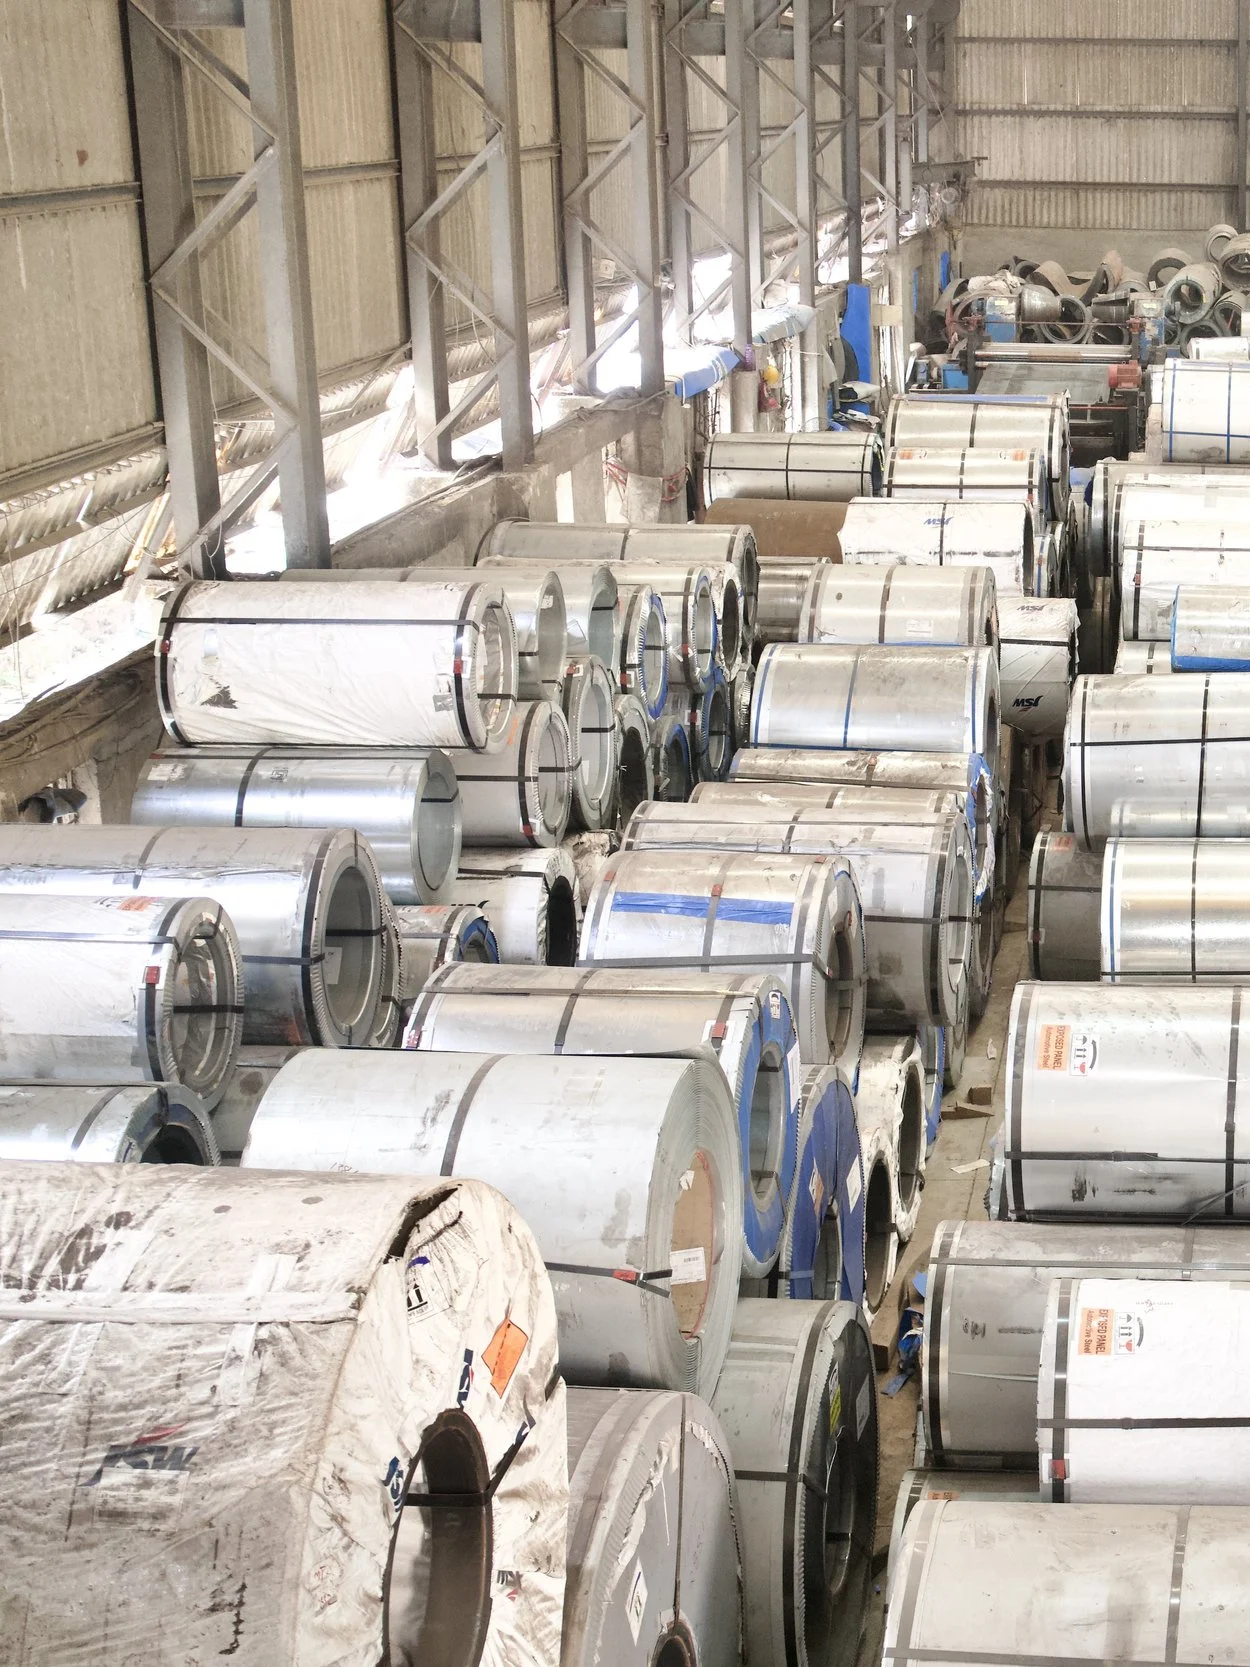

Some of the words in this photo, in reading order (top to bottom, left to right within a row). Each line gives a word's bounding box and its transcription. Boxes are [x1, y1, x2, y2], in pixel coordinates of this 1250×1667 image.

[1012, 695, 1044, 707] JSW
[1055, 1025, 1066, 1050] EXPOSED
[1052, 1050, 1063, 1070] PANEL
[1083, 1339, 1093, 1354] Steel
[1095, 1334, 1107, 1354] PANEL
